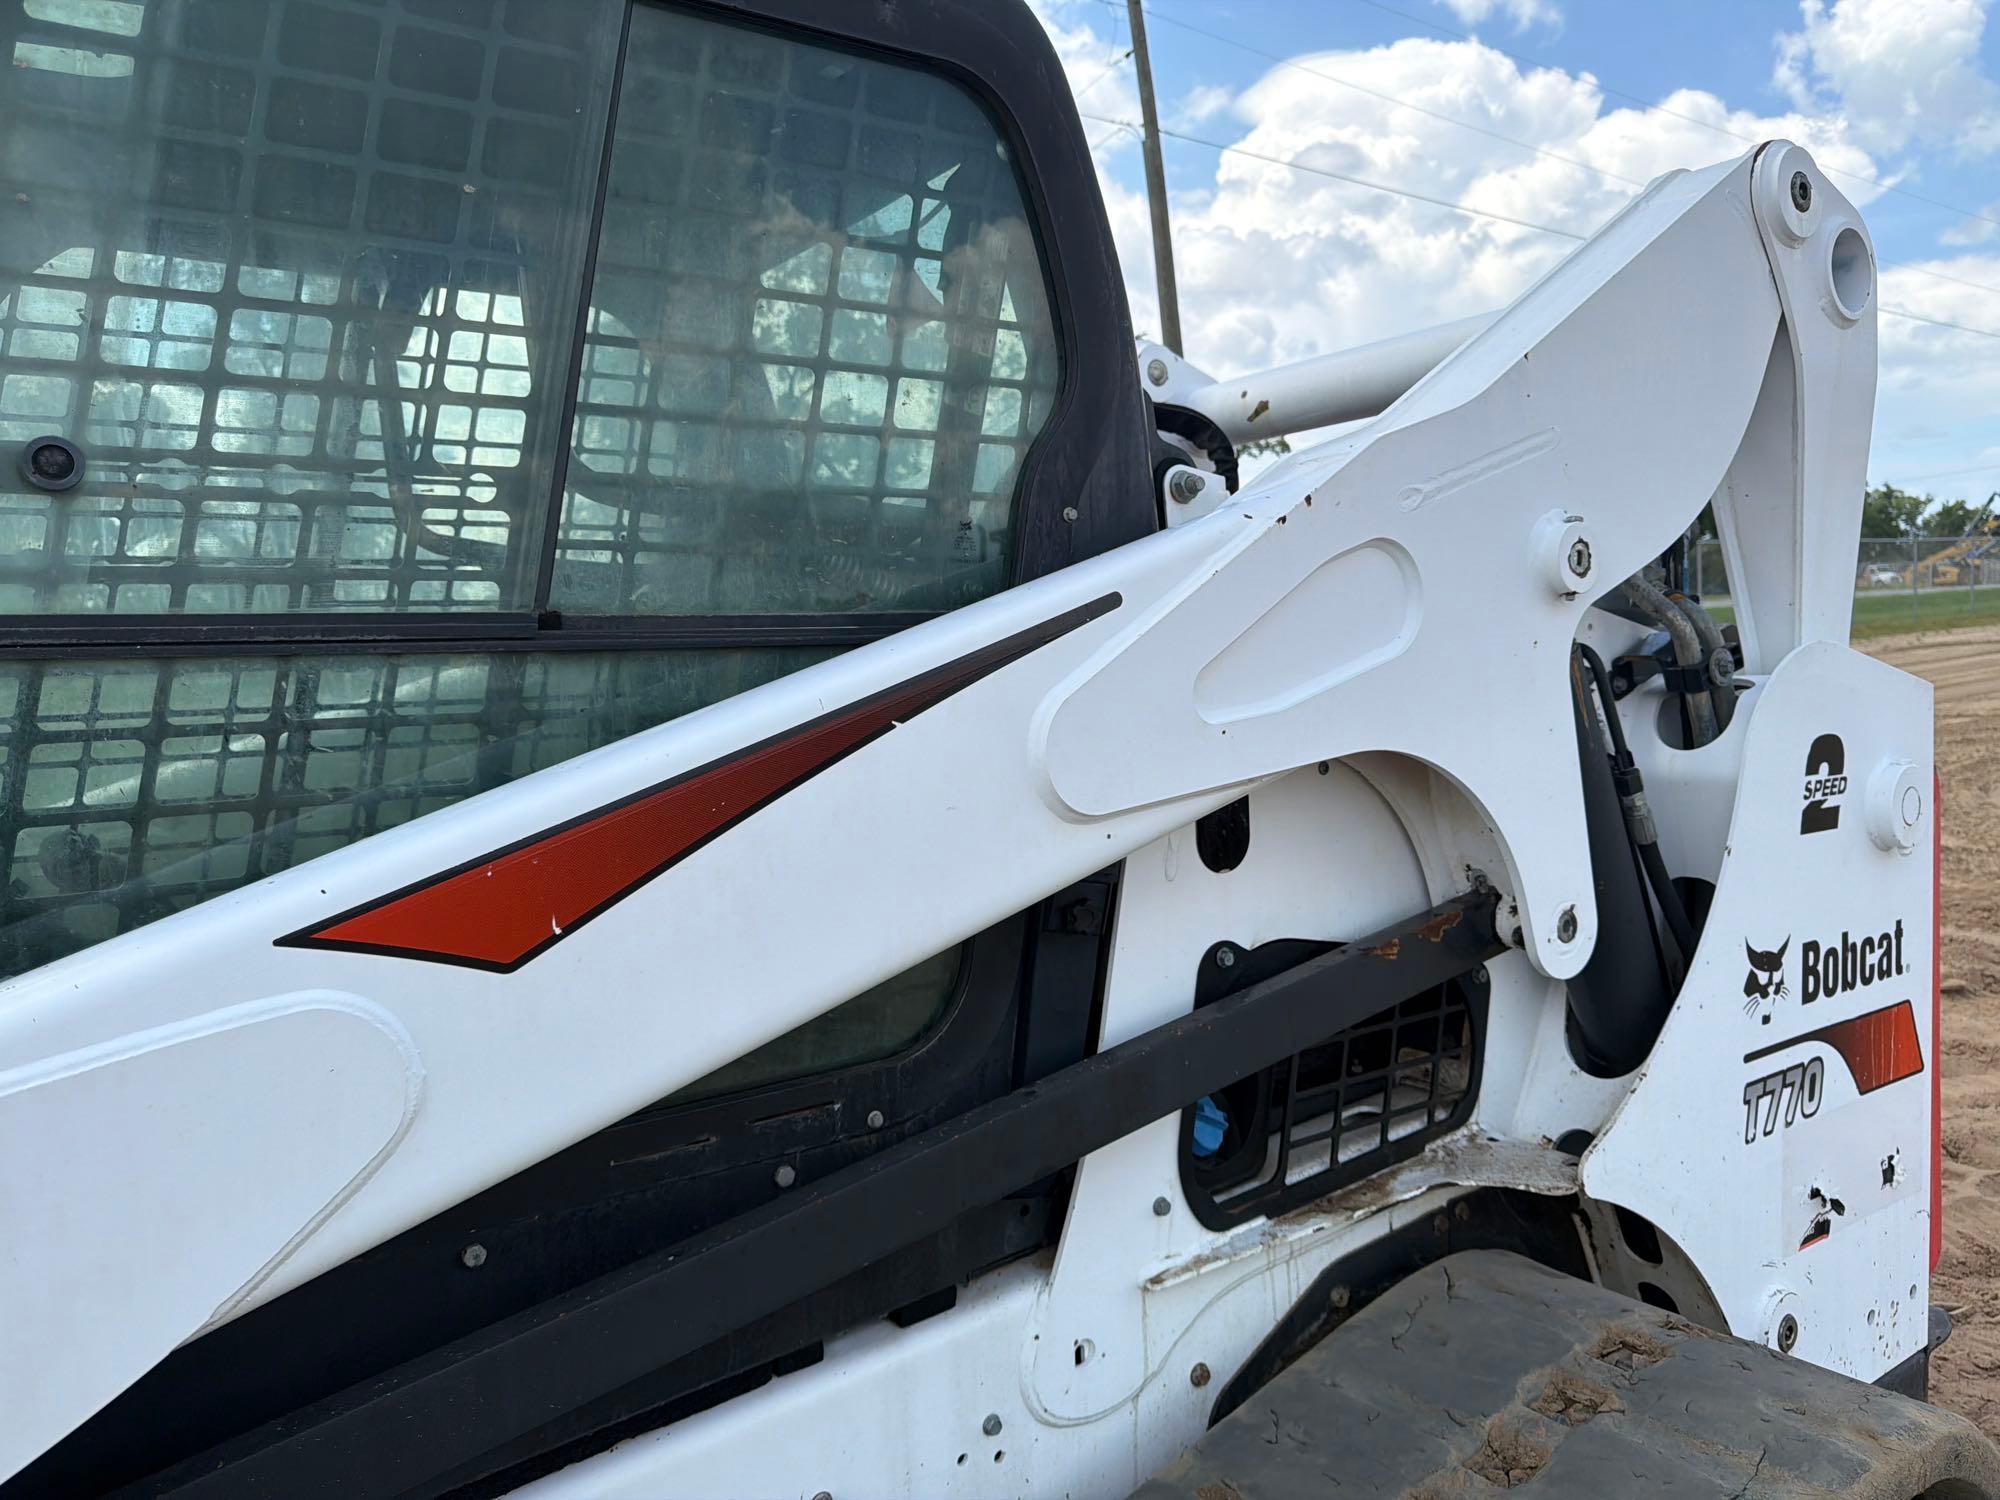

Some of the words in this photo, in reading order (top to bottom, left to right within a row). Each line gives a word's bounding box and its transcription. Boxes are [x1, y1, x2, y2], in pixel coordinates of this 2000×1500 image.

[1800, 733, 1845, 835] 2
[1803, 776, 1848, 801] SPEED
[1801, 919, 1904, 1006] Bobcat
[1743, 1056, 1824, 1145] T770
